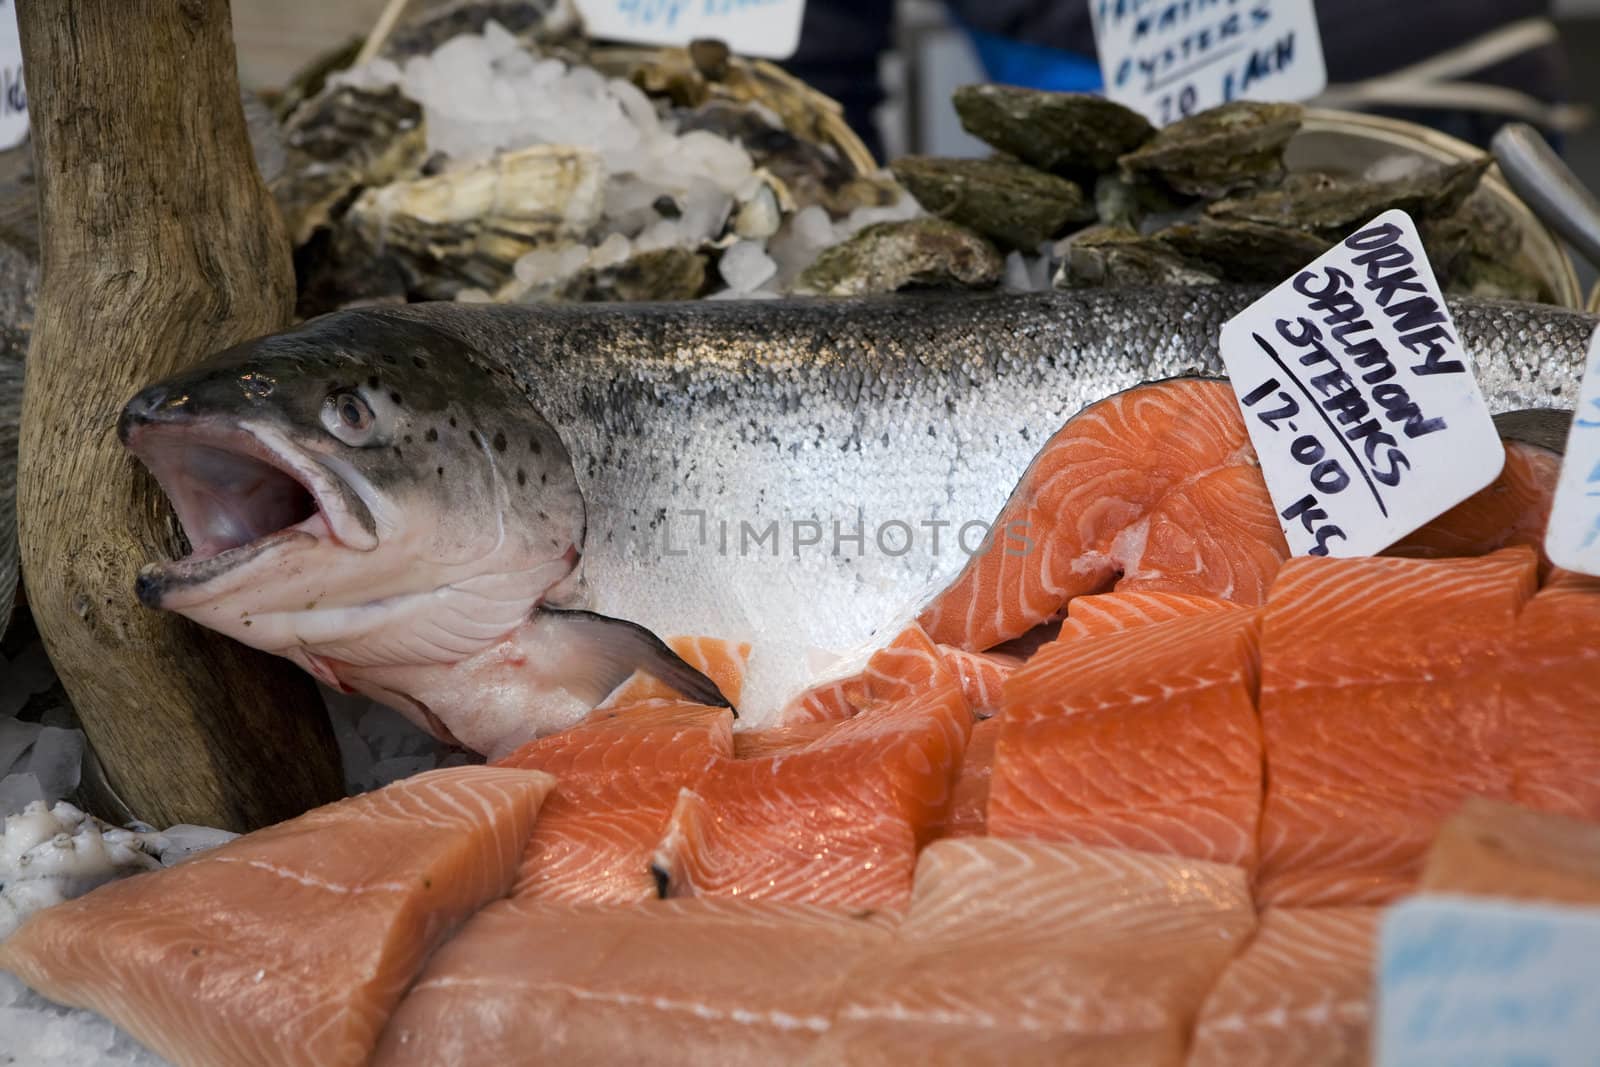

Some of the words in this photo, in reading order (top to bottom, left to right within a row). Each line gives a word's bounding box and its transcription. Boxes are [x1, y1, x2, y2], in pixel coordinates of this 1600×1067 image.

[1293, 267, 1447, 439] SALMON
[1345, 223, 1466, 376] ORKNEY
[1275, 317, 1410, 487] STEAKS
